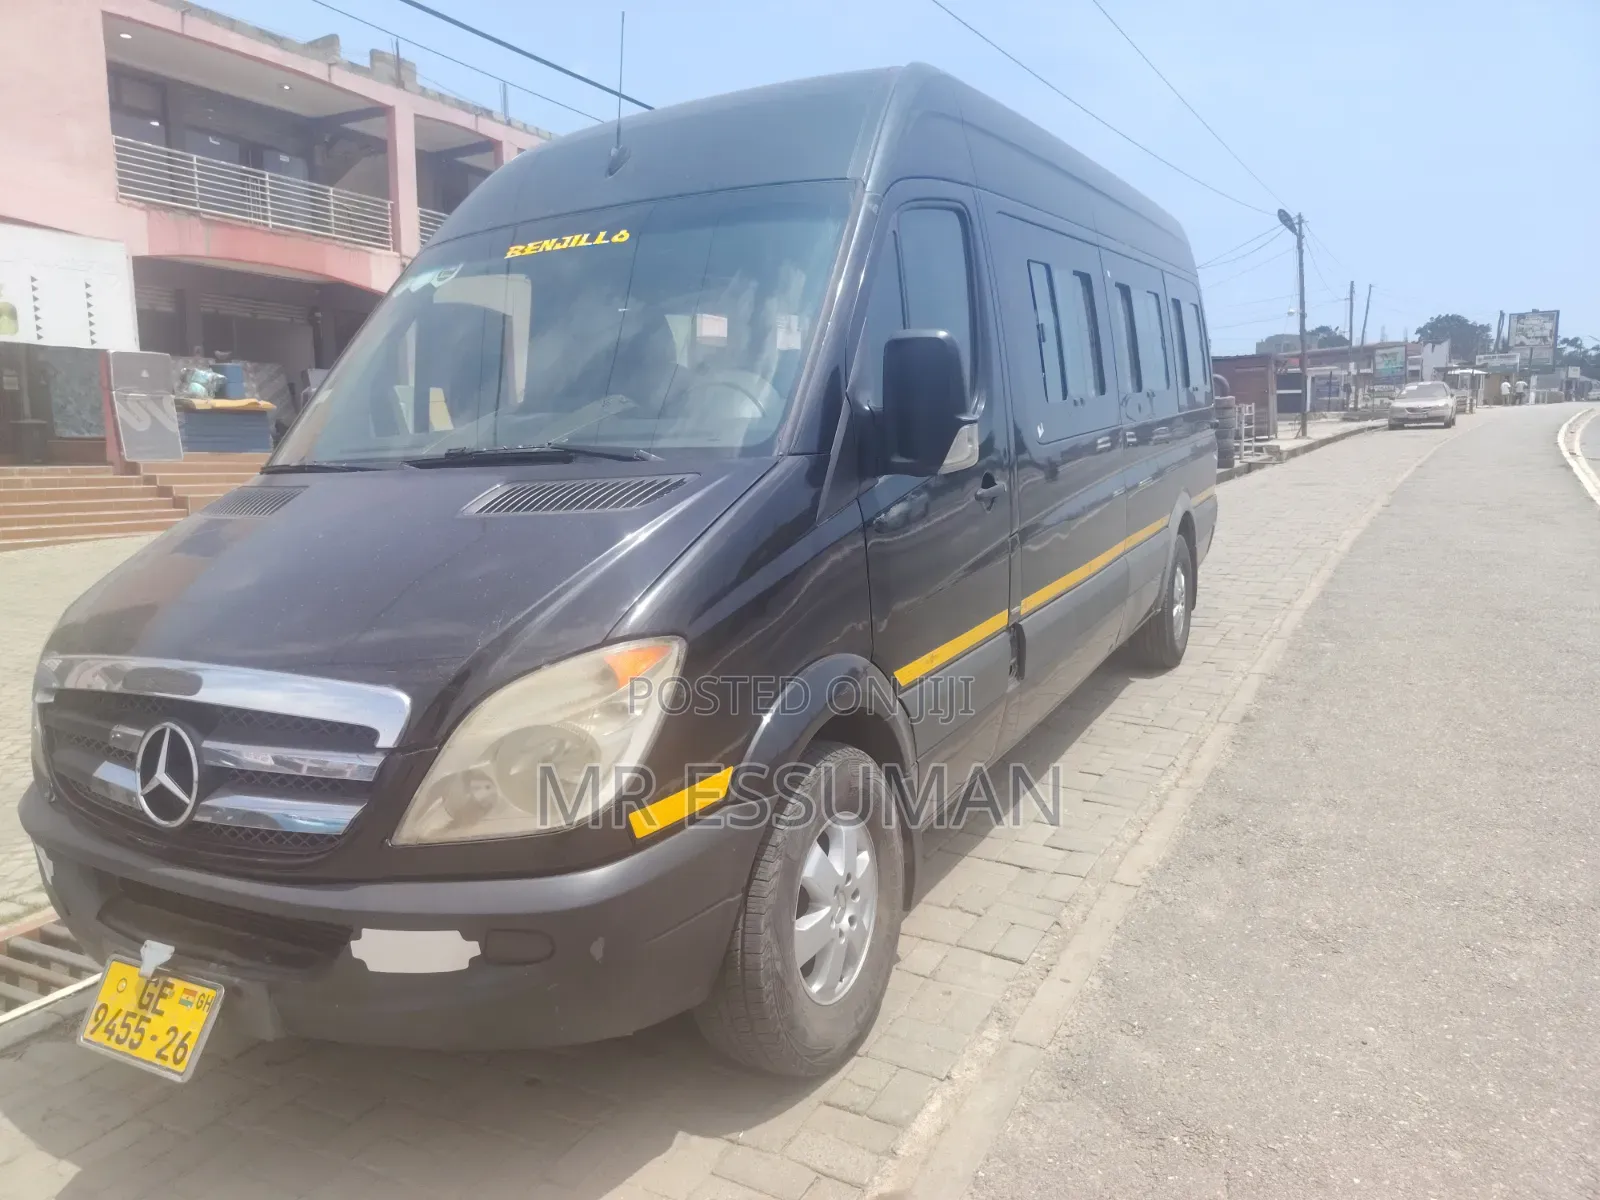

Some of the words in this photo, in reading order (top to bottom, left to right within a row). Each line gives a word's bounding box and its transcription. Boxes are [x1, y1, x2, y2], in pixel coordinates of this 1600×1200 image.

[137, 978, 175, 1017] GE
[195, 993, 215, 1013] GH
[89, 1003, 193, 1066] 9455-26
